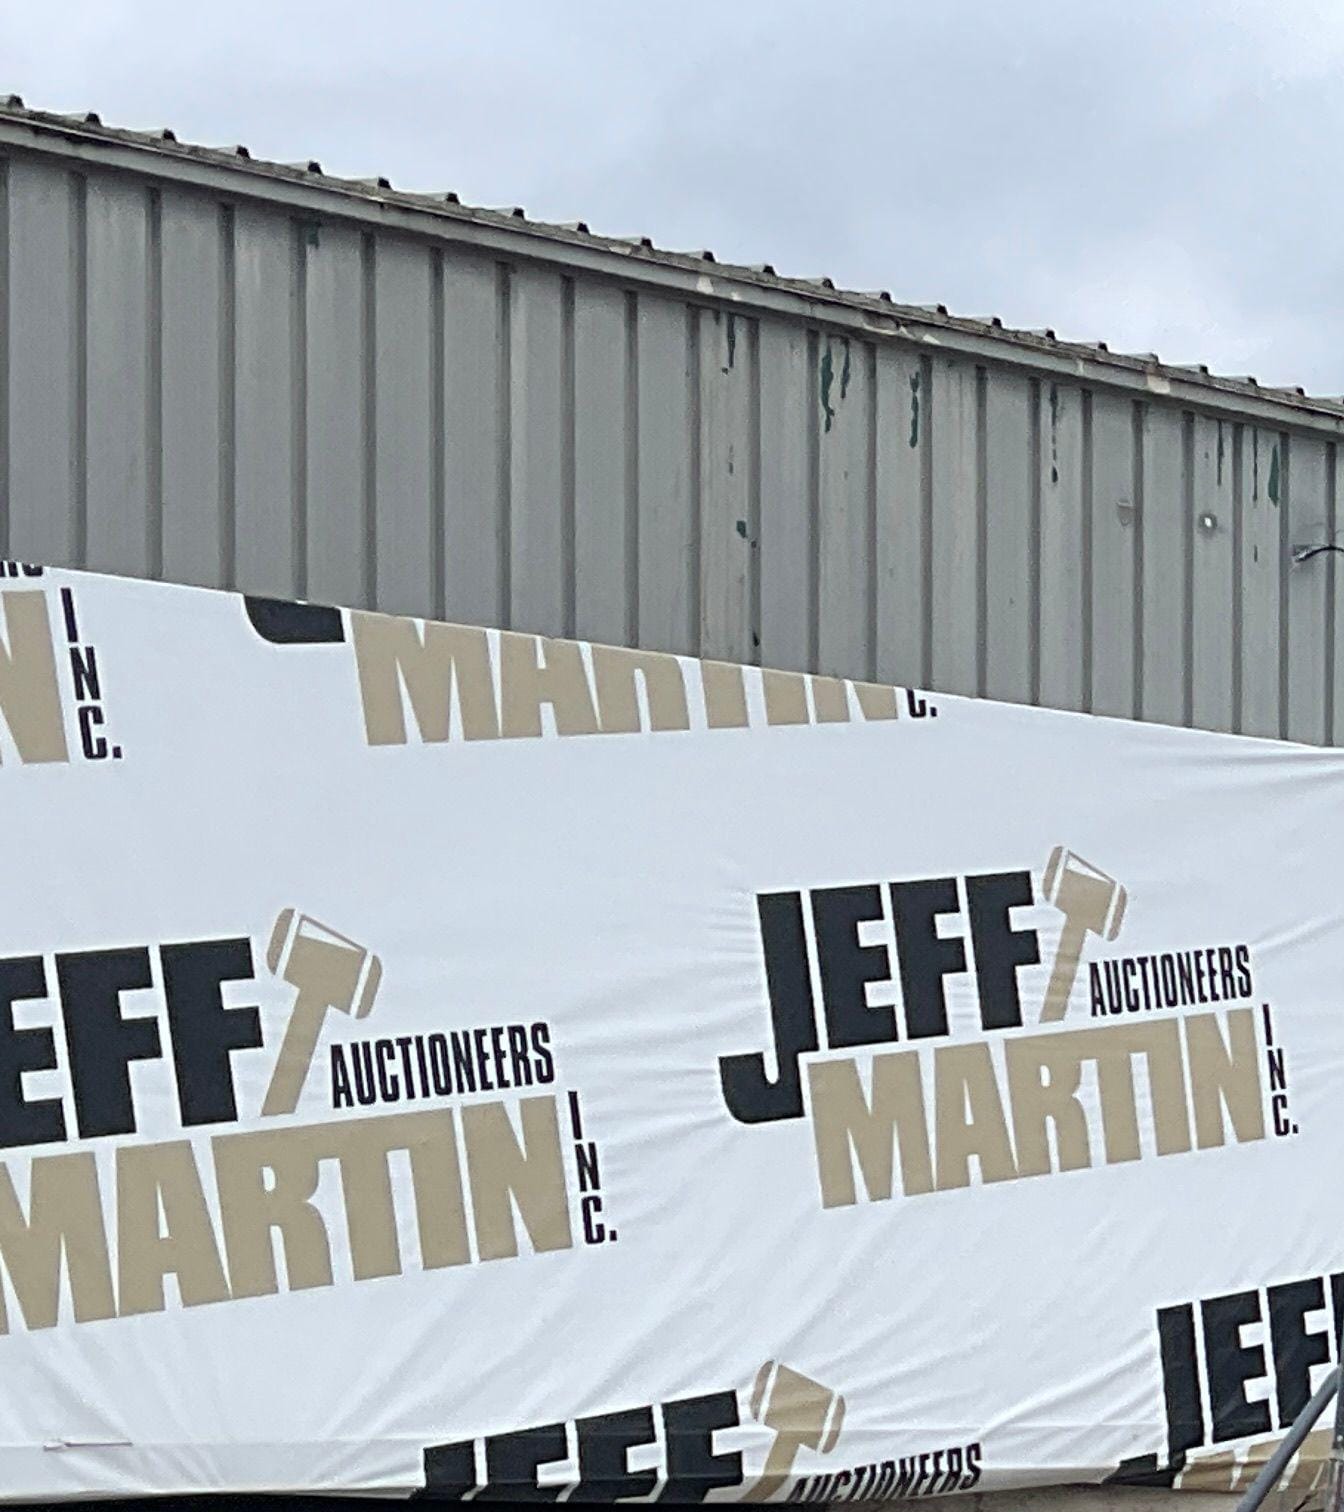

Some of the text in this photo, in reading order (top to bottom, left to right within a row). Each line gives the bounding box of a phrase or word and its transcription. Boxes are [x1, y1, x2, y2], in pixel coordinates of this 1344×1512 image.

[718, 870, 1041, 1125] JEFF
[1089, 944, 1253, 1018] AUCTIONEERS
[329, 1021, 556, 1109] AUCTIONEERS
[807, 1007, 1267, 1210] MARTIN
[1262, 1003, 1300, 1137] INC.
[0, 1096, 573, 1336] MARTIN
[567, 1091, 618, 1246] INC.
